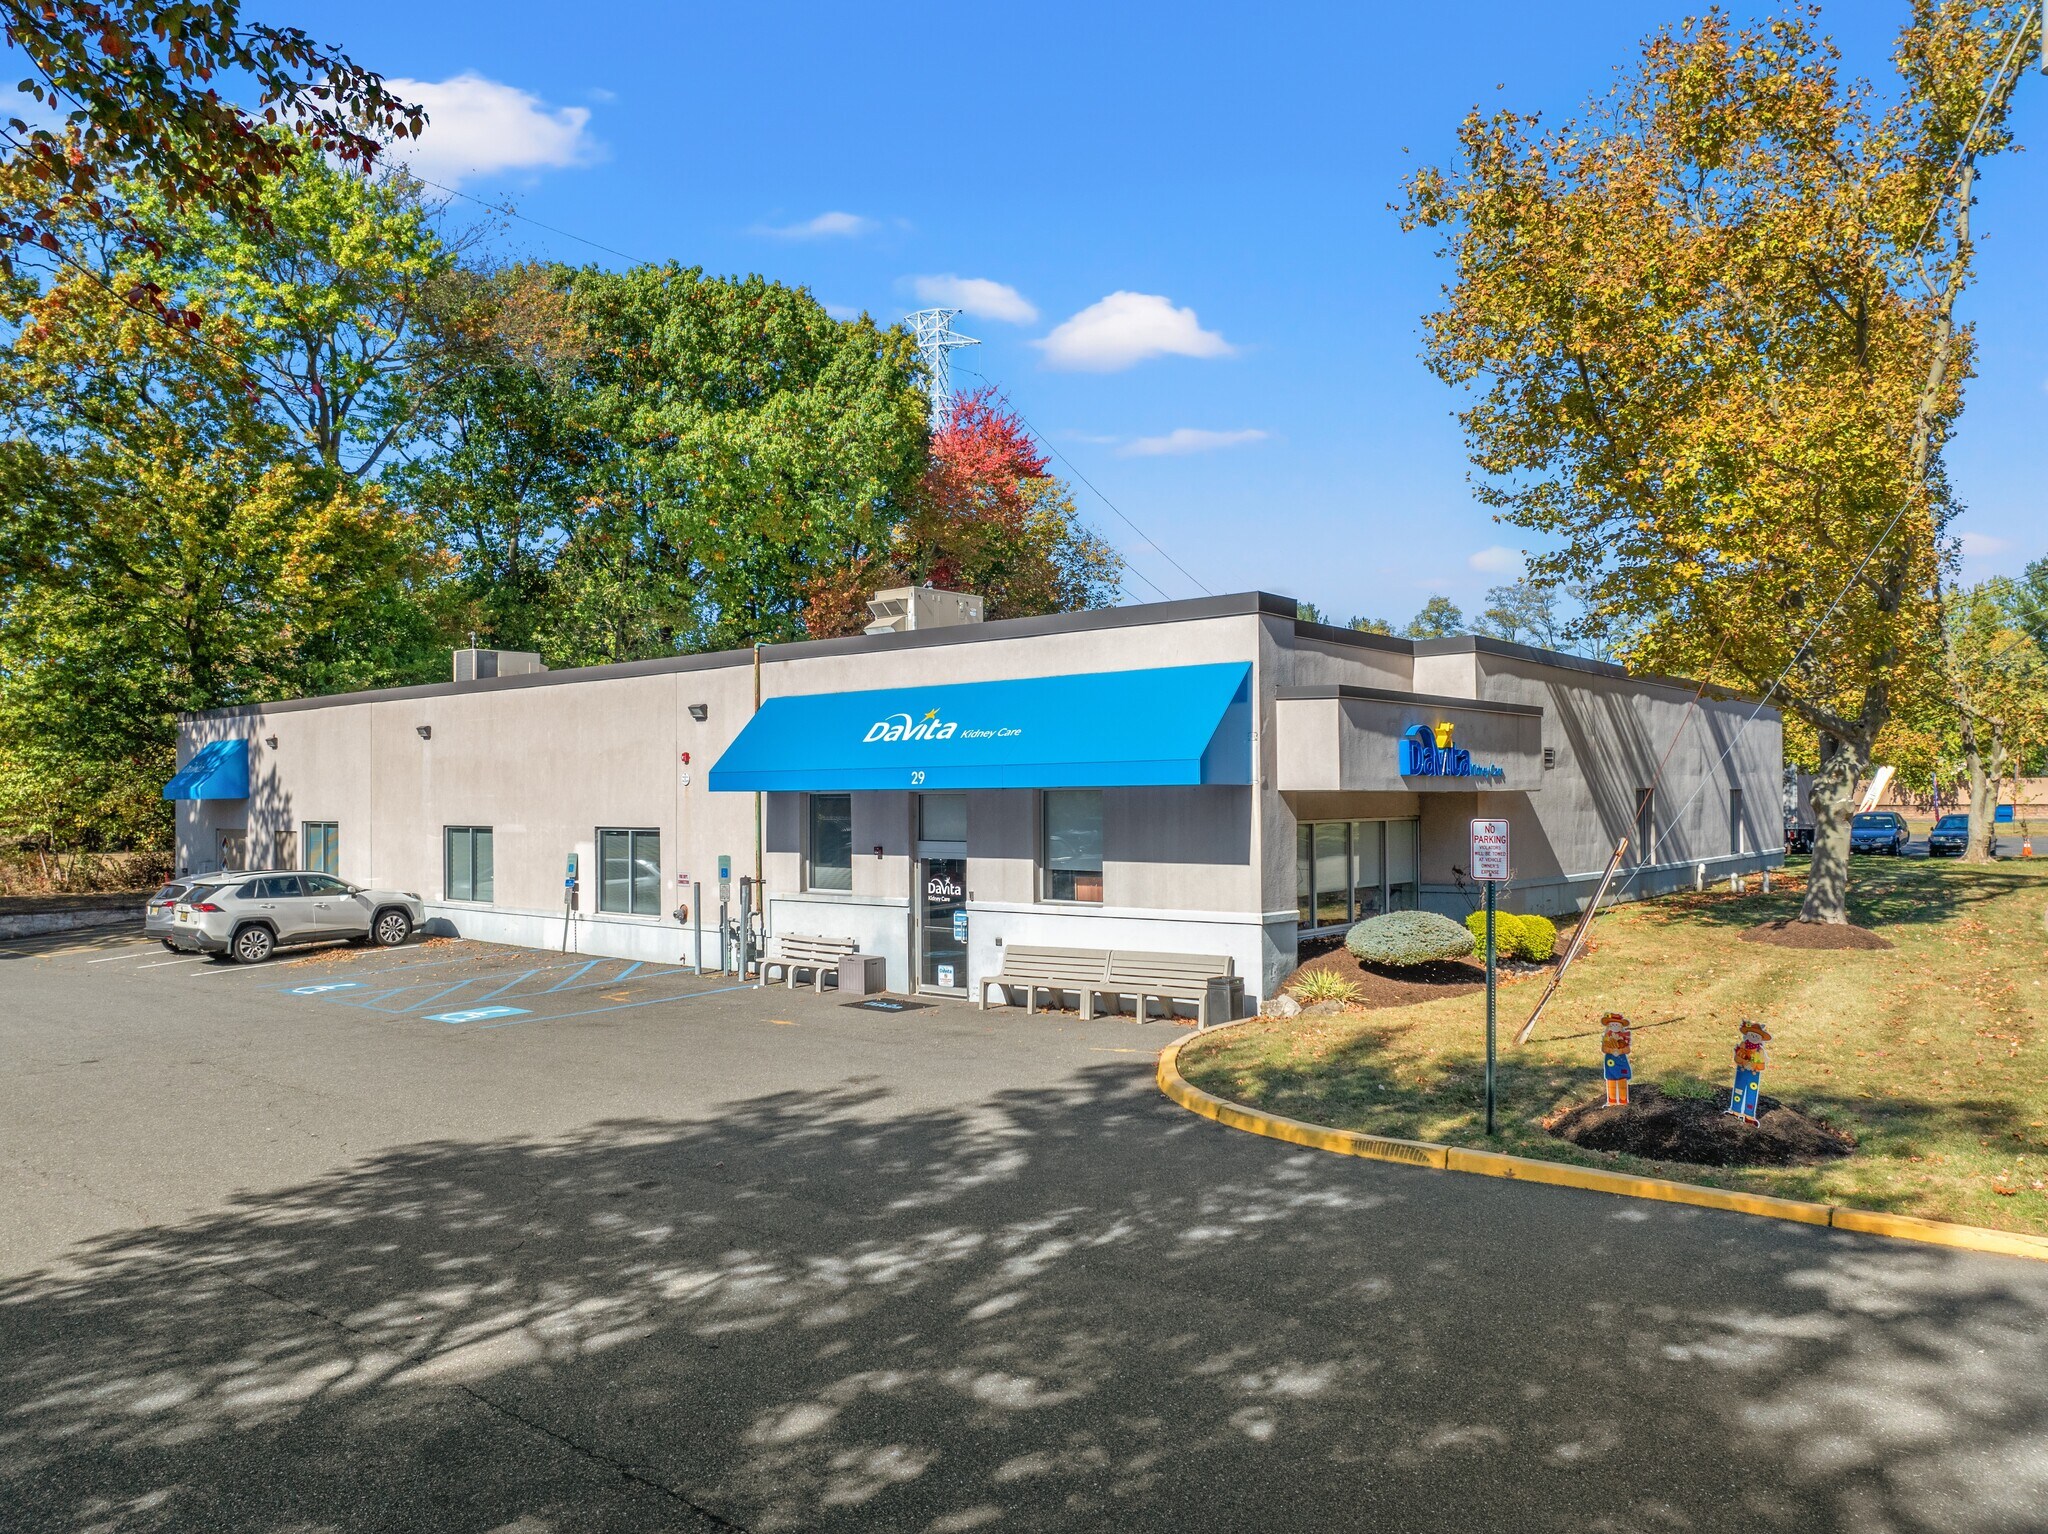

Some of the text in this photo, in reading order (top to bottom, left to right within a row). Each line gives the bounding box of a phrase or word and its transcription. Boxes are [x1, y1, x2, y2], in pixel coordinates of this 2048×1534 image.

[862, 712, 1022, 743] DaVita Kidney Care
[1399, 724, 1471, 777] DaVita
[911, 770, 926, 785] 29
[1485, 825, 1495, 833] NO
[1474, 835, 1506, 844] PARKING
[928, 878, 962, 896] DaVita
